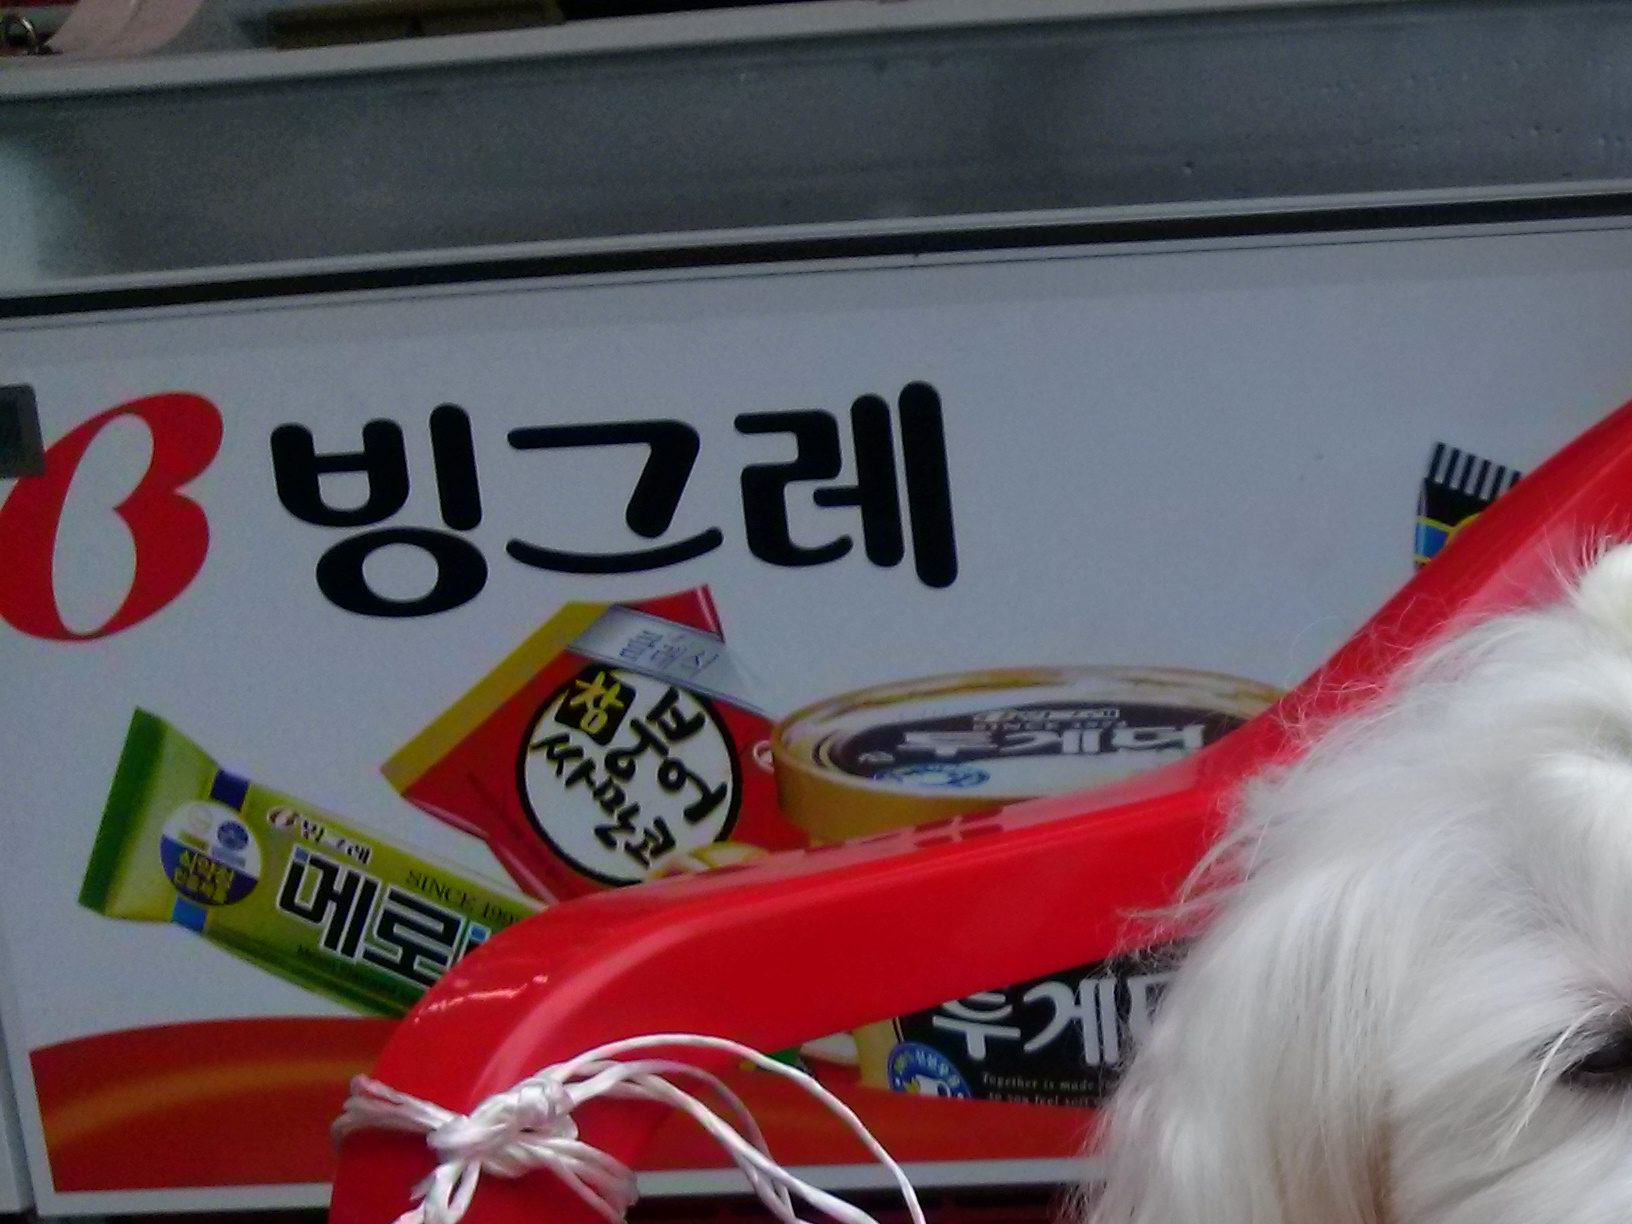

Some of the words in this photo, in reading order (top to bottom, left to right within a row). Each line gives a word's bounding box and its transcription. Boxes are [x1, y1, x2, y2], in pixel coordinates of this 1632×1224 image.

[269, 380, 959, 618] 빙그레
[277, 845, 492, 987] 메로
[406, 868, 477, 915] SINCE
